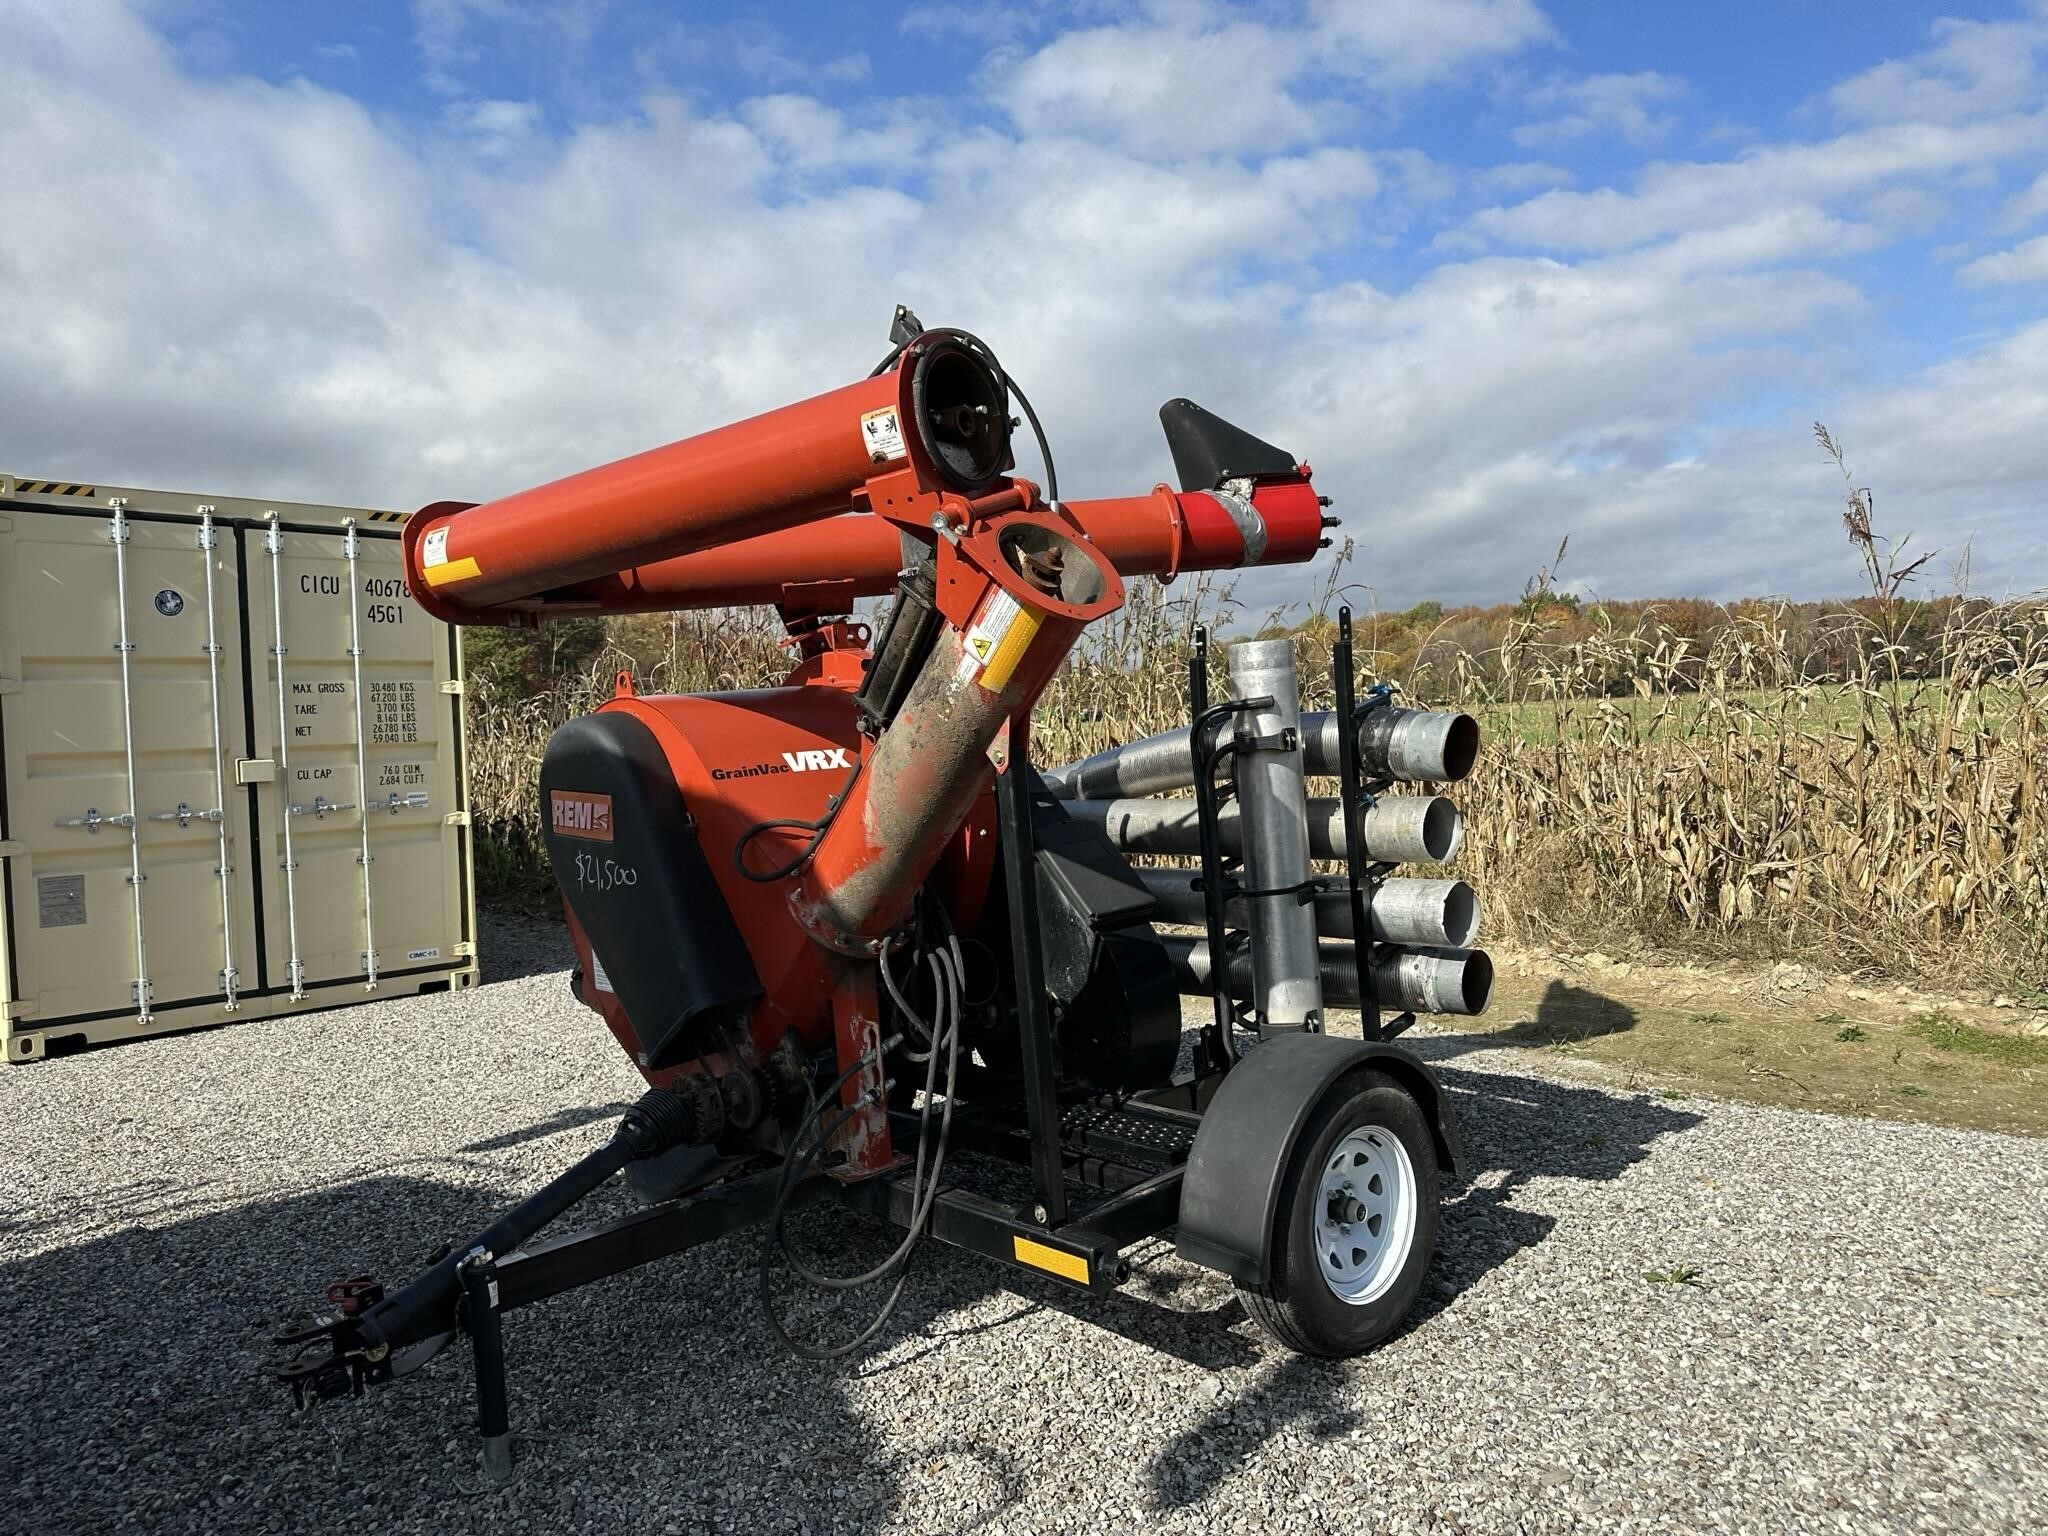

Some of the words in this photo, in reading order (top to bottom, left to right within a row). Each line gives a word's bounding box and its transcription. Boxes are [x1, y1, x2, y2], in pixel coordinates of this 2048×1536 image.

[300, 575, 340, 595] CICU
[367, 604, 403, 624] 45G1
[318, 682, 345, 693] GROSS
[370, 682, 396, 693] 30.480
[371, 693, 397, 703] 67.200
[294, 704, 318, 715] TARE
[376, 703, 397, 713] 3.700
[377, 713, 398, 723] 8.160
[295, 726, 312, 737] NET
[373, 723, 398, 734] 26.780
[373, 733, 399, 744] 59.040
[711, 763, 790, 781] GrainVac
[781, 748, 852, 772] VRX
[297, 770, 311, 780] CU.
[551, 800, 592, 830] REM
[575, 850, 638, 893] $21,500
